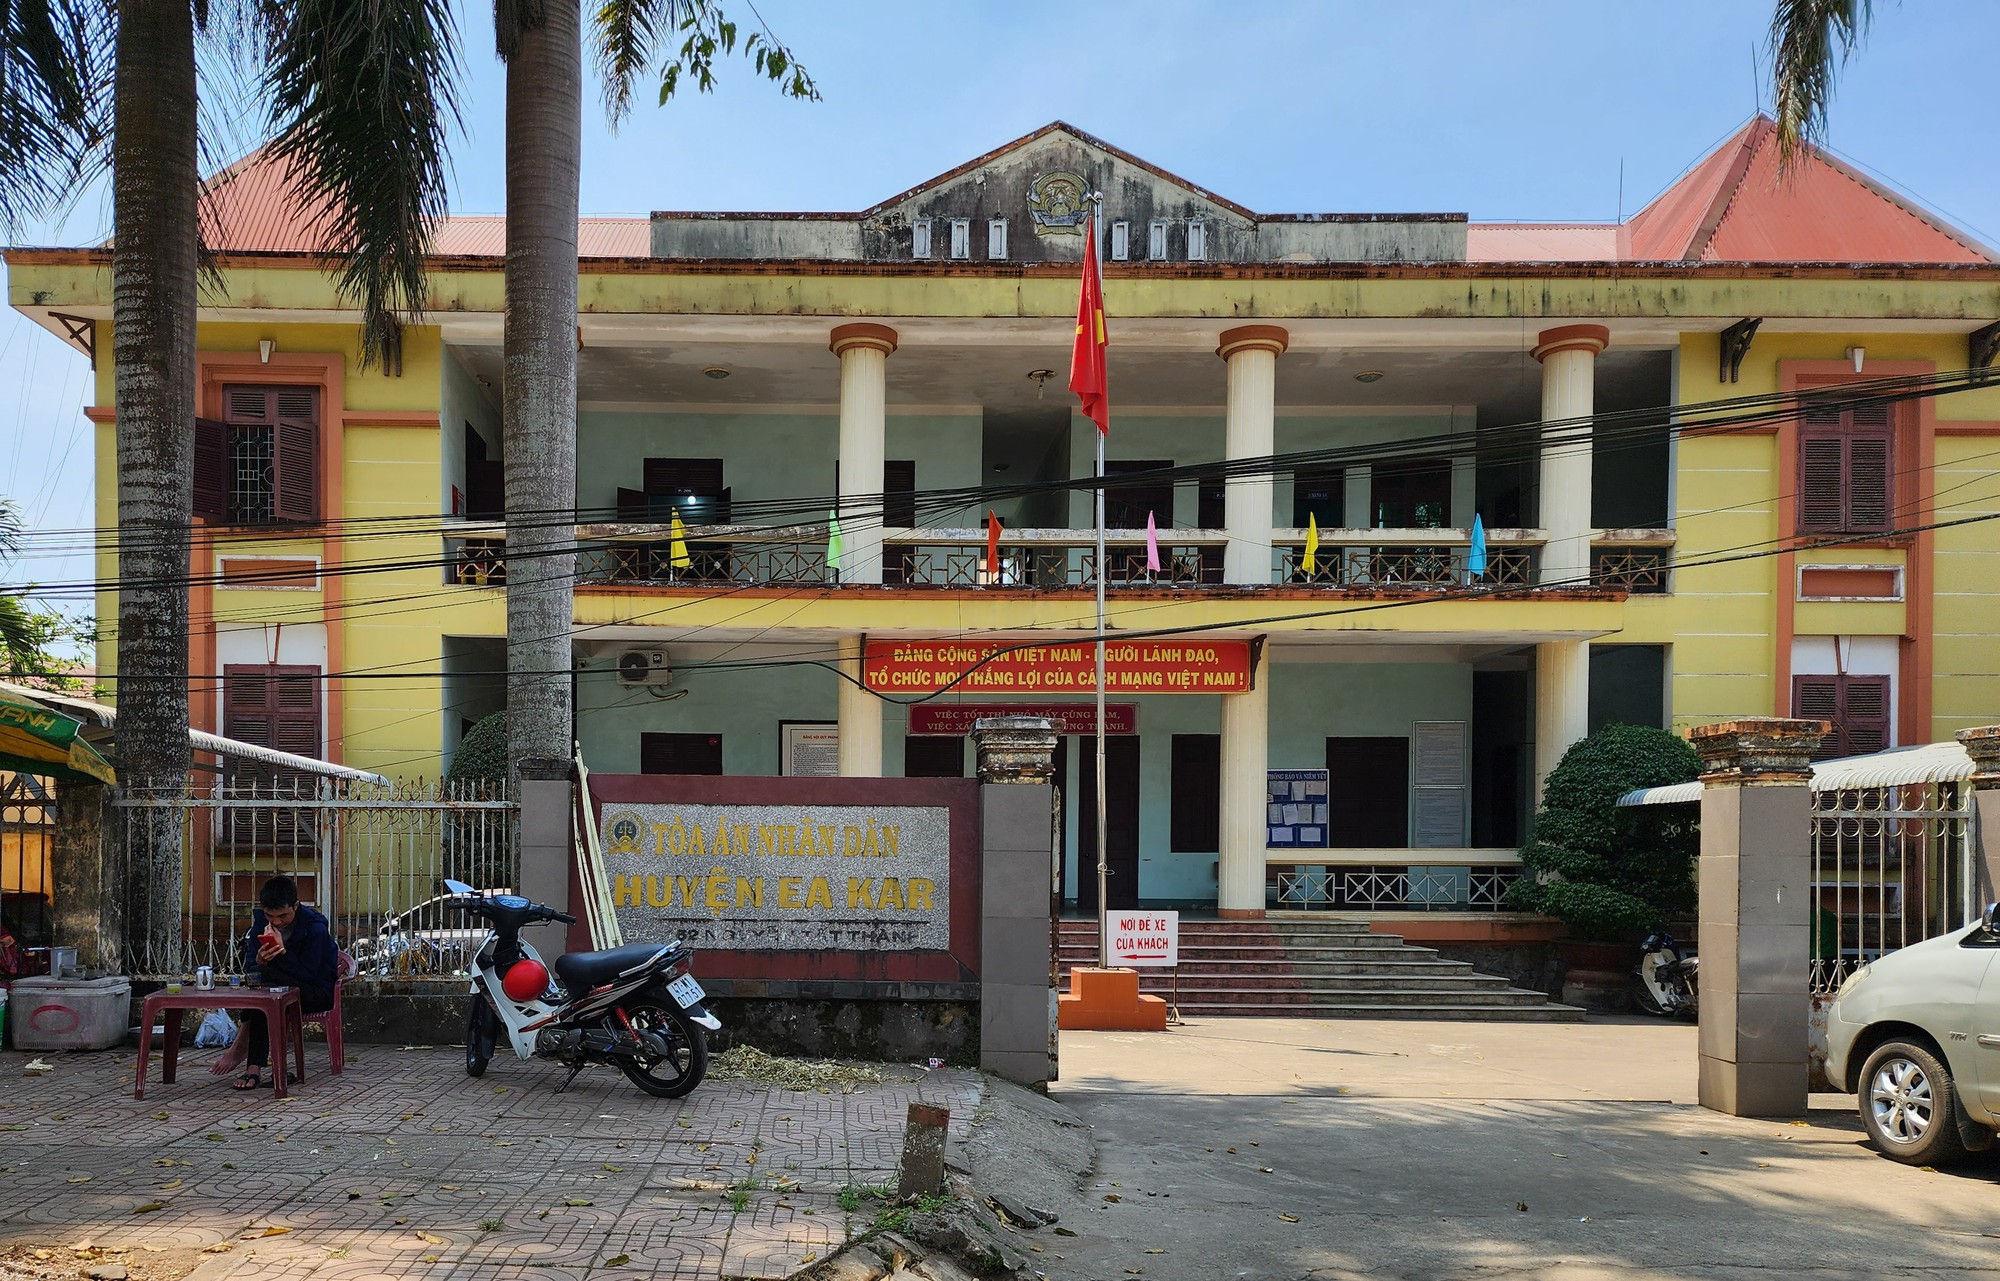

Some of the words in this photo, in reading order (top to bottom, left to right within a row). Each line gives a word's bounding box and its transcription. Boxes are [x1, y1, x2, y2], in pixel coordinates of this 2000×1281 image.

[894, 644, 933, 662] ĐẢNG
[938, 646, 977, 666] CỘNG
[981, 644, 1010, 662] SẢN
[1014, 646, 1046, 666] VIỆT
[1050, 648, 1081, 662] NAM
[1144, 645, 1182, 662] LÃNH
[1185, 648, 1219, 666] ĐẠO,
[869, 665, 888, 685] TỔ
[891, 668, 931, 685] CHỨC
[935, 671, 960, 689] MỌI
[967, 666, 1014, 685] THẮNG
[1018, 669, 1041, 689] LỢI
[1045, 666, 1074, 685] CỦA
[1077, 668, 1117, 685] CÁH
[1121, 671, 1163, 689] MẠNG
[1167, 669, 1200, 689] VIỆT
[1204, 672, 1236, 685] NAM
[0, 705, 56, 731] ANH
[934, 709, 960, 719] VIỆC
[963, 709, 984, 719] TỐT
[927, 721, 953, 731] VIỆC
[1088, 721, 1128, 730] TÁNH.
[652, 813, 706, 855] TÒA
[711, 815, 751, 856] ÁN
[756, 816, 836, 857] NHÂN
[843, 817, 900, 857] DÂN
[614, 866, 764, 916] HUYỆN
[778, 876, 834, 909] EA
[847, 876, 936, 910] KAR
[1120, 917, 1136, 931] NƠI
[1138, 913, 1152, 931] ĐỂ
[1154, 919, 1166, 931] XE
[1116, 933, 1135, 950] CỦA
[1137, 934, 1169, 950] KHÁCH
